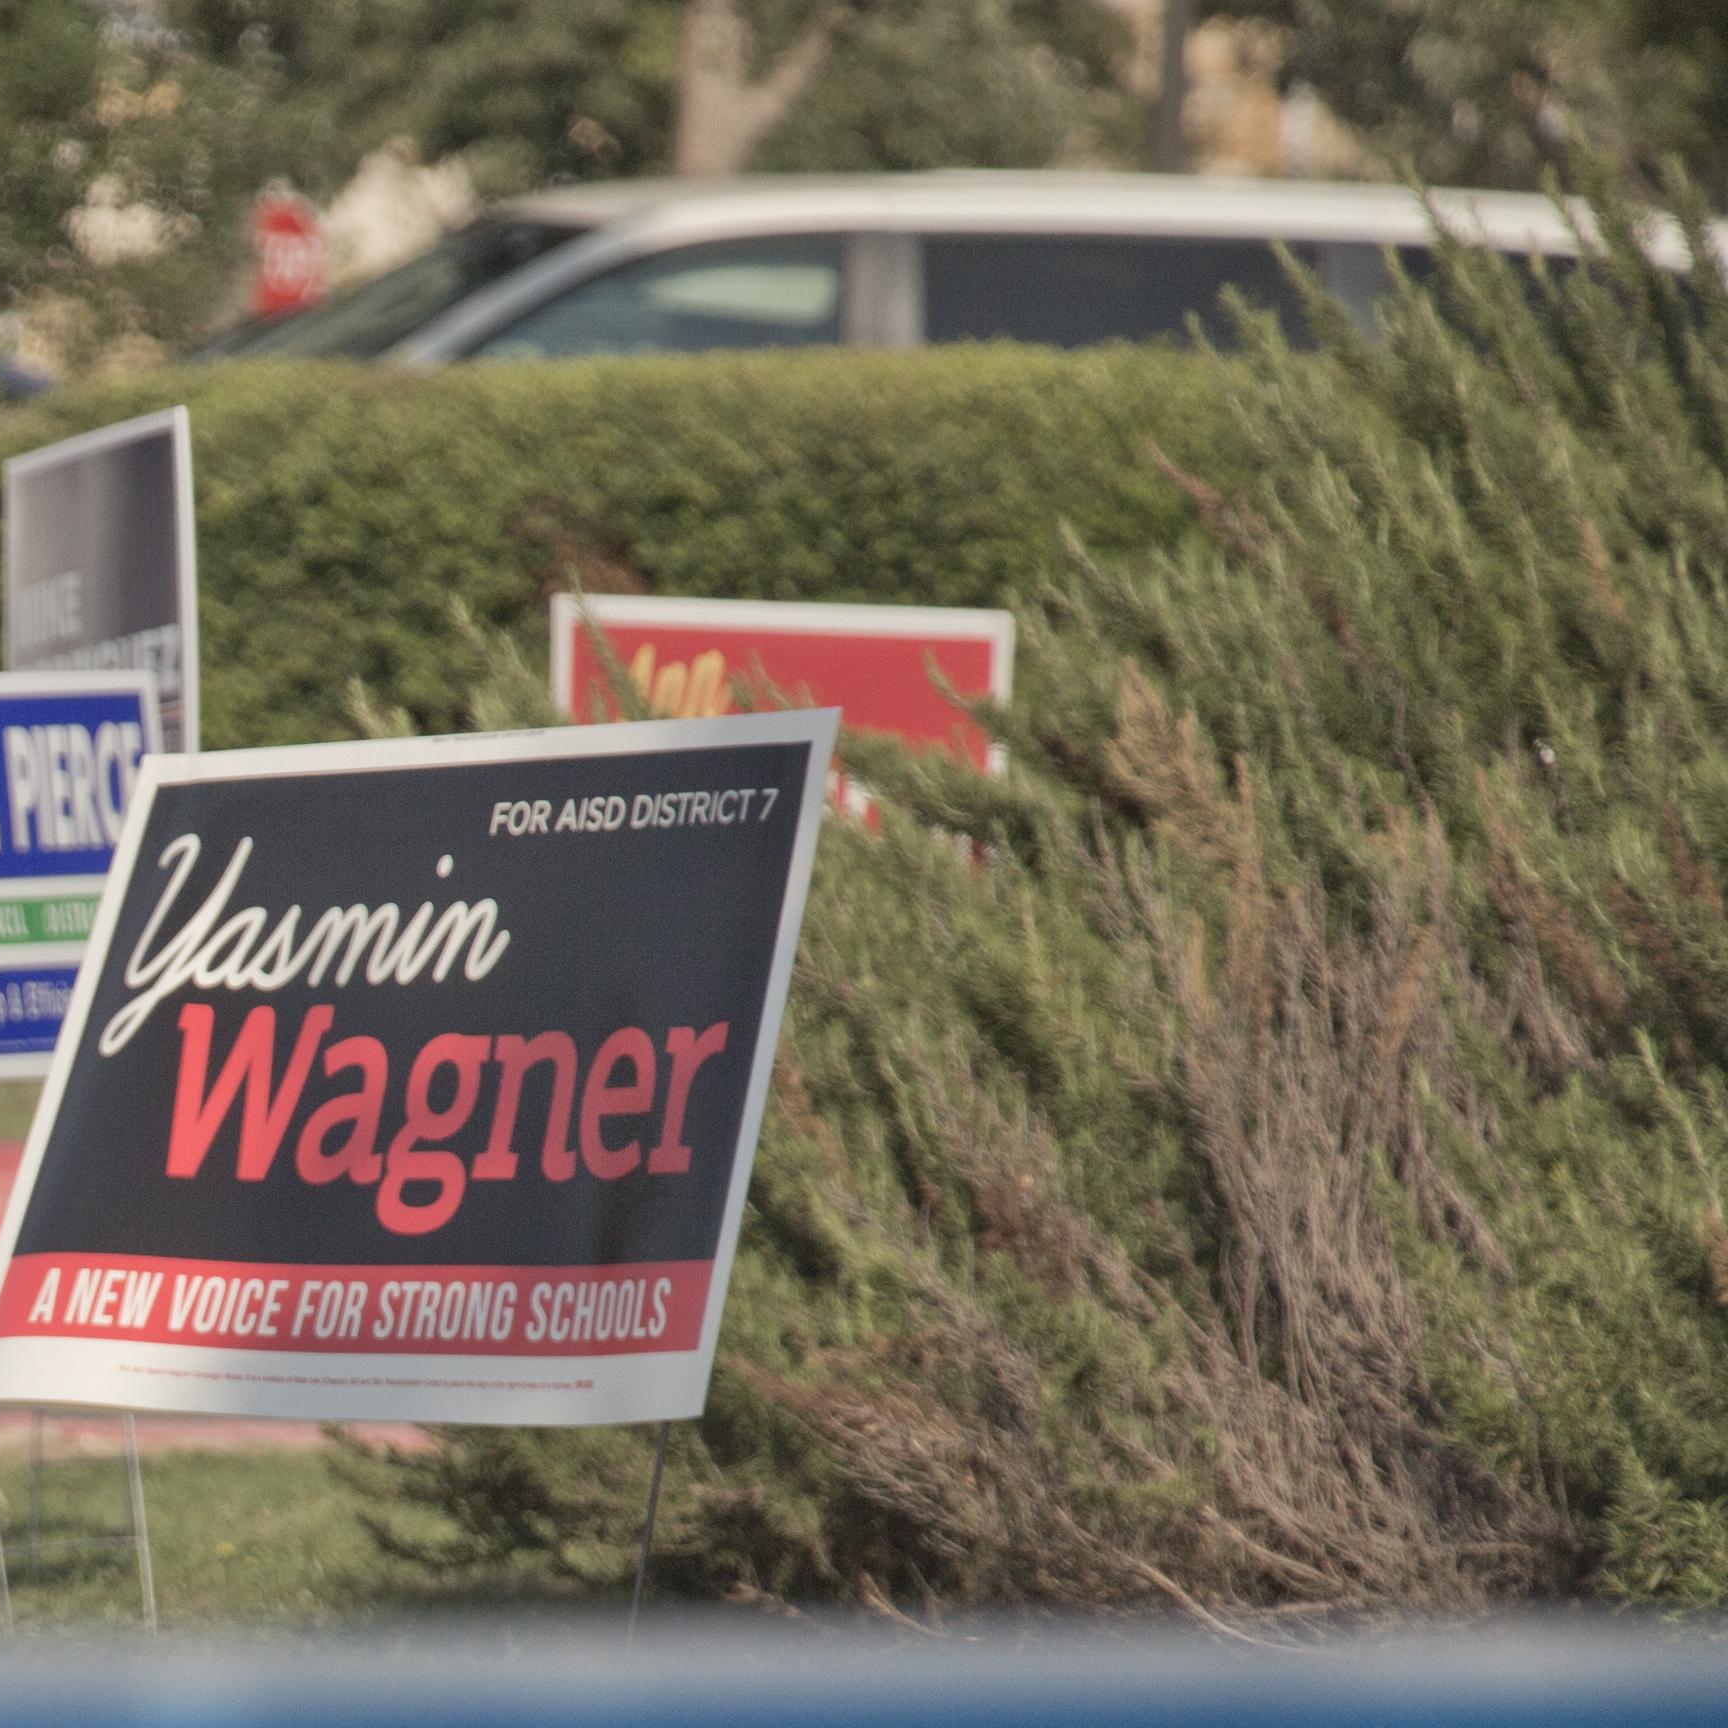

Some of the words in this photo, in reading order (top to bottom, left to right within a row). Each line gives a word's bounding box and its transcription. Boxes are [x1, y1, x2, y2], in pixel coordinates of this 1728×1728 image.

[489, 800, 552, 837] FOR
[554, 795, 626, 834] AISD
[629, 788, 757, 830] DISTRICT
[758, 787, 779, 822] 7
[98, 831, 512, 1058] Yasmin
[166, 1002, 730, 1237] Wagner
[28, 1267, 56, 1324] A
[63, 1269, 162, 1329] NEW
[167, 1273, 282, 1337] VOICE
[291, 1280, 368, 1339] FOR
[373, 1280, 516, 1341] STRONG
[526, 1276, 672, 1341] SCHOOLS
